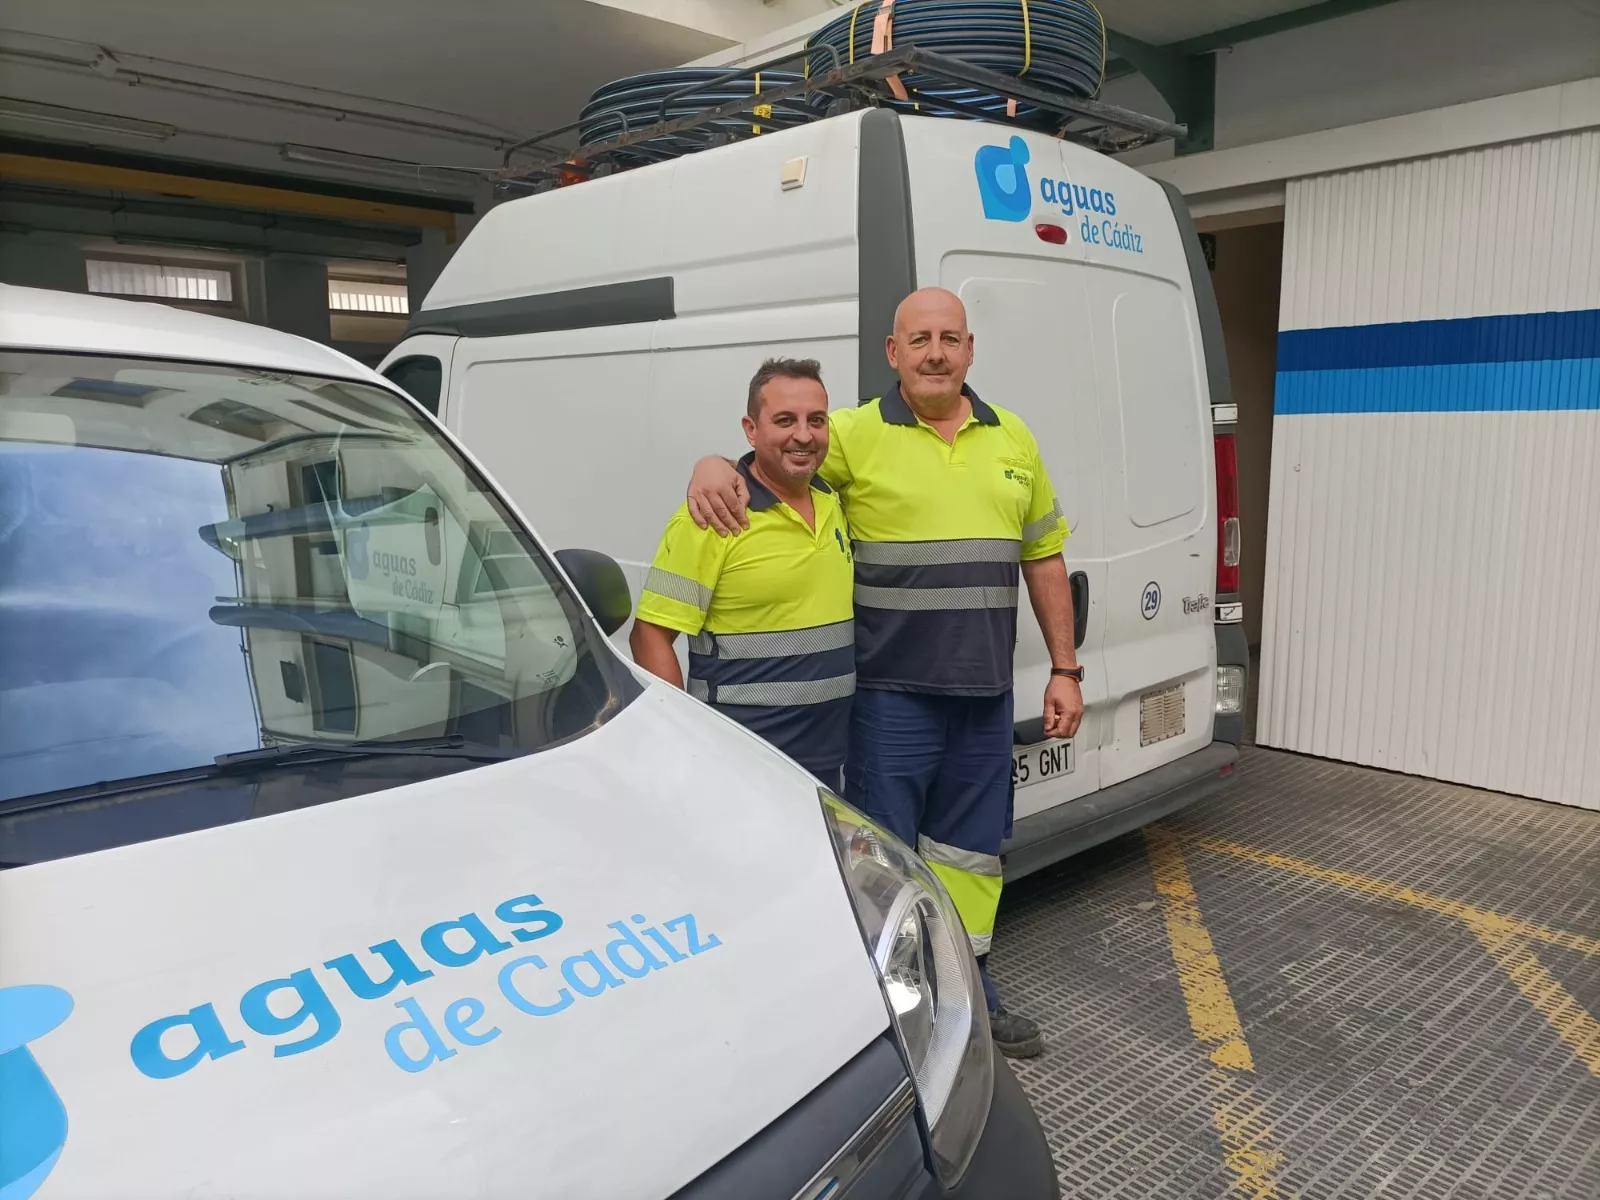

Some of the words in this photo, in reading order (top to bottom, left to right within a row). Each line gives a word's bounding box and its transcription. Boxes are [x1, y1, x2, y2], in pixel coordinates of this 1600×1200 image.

[1040, 177, 1117, 216] aguas
[1080, 215, 1100, 245] de
[1102, 219, 1143, 253] Cádiz
[373, 550, 417, 577] aguas
[392, 575, 404, 597] de
[1144, 590, 1158, 612] 29
[1039, 743, 1071, 777] GNT
[130, 894, 564, 1080] aguas
[385, 998, 502, 1073] de
[497, 913, 723, 1017] Cadiz
